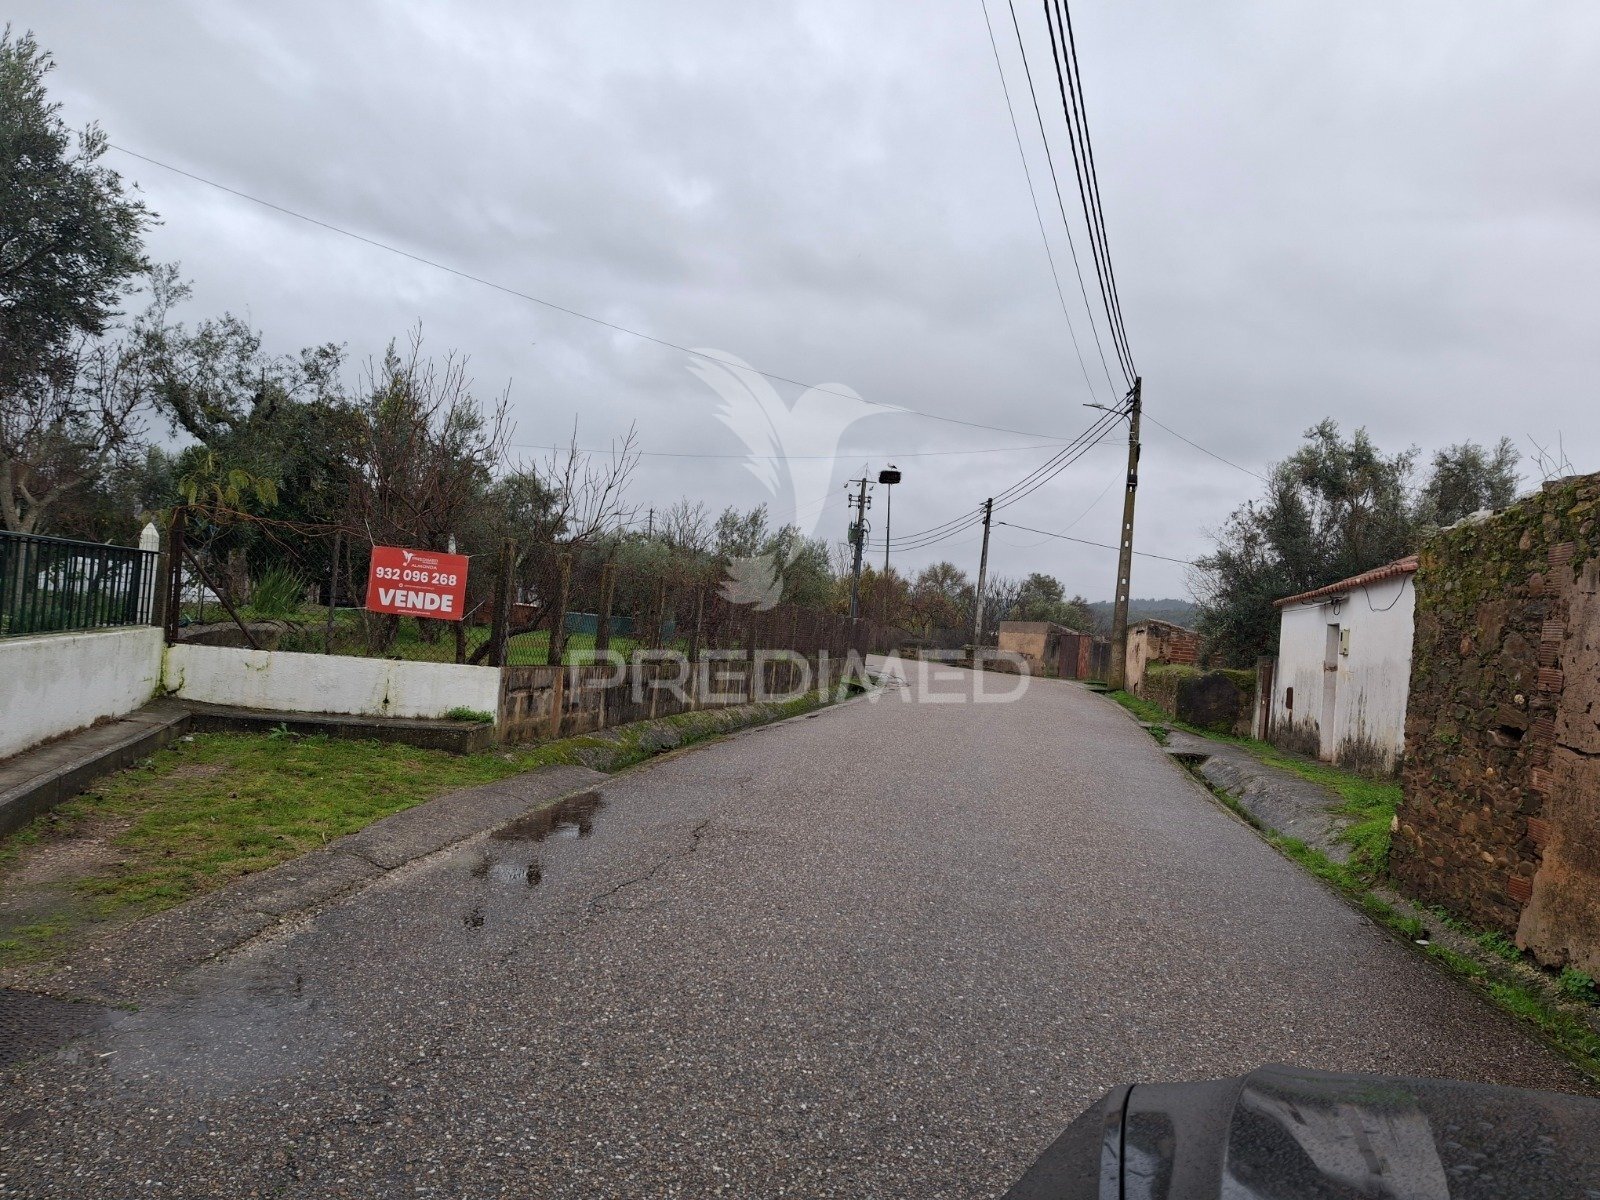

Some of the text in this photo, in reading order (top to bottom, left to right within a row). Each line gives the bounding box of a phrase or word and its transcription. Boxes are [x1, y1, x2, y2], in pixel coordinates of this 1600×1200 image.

[376, 567, 457, 586] 932 096 268
[378, 587, 453, 612] VENDE
